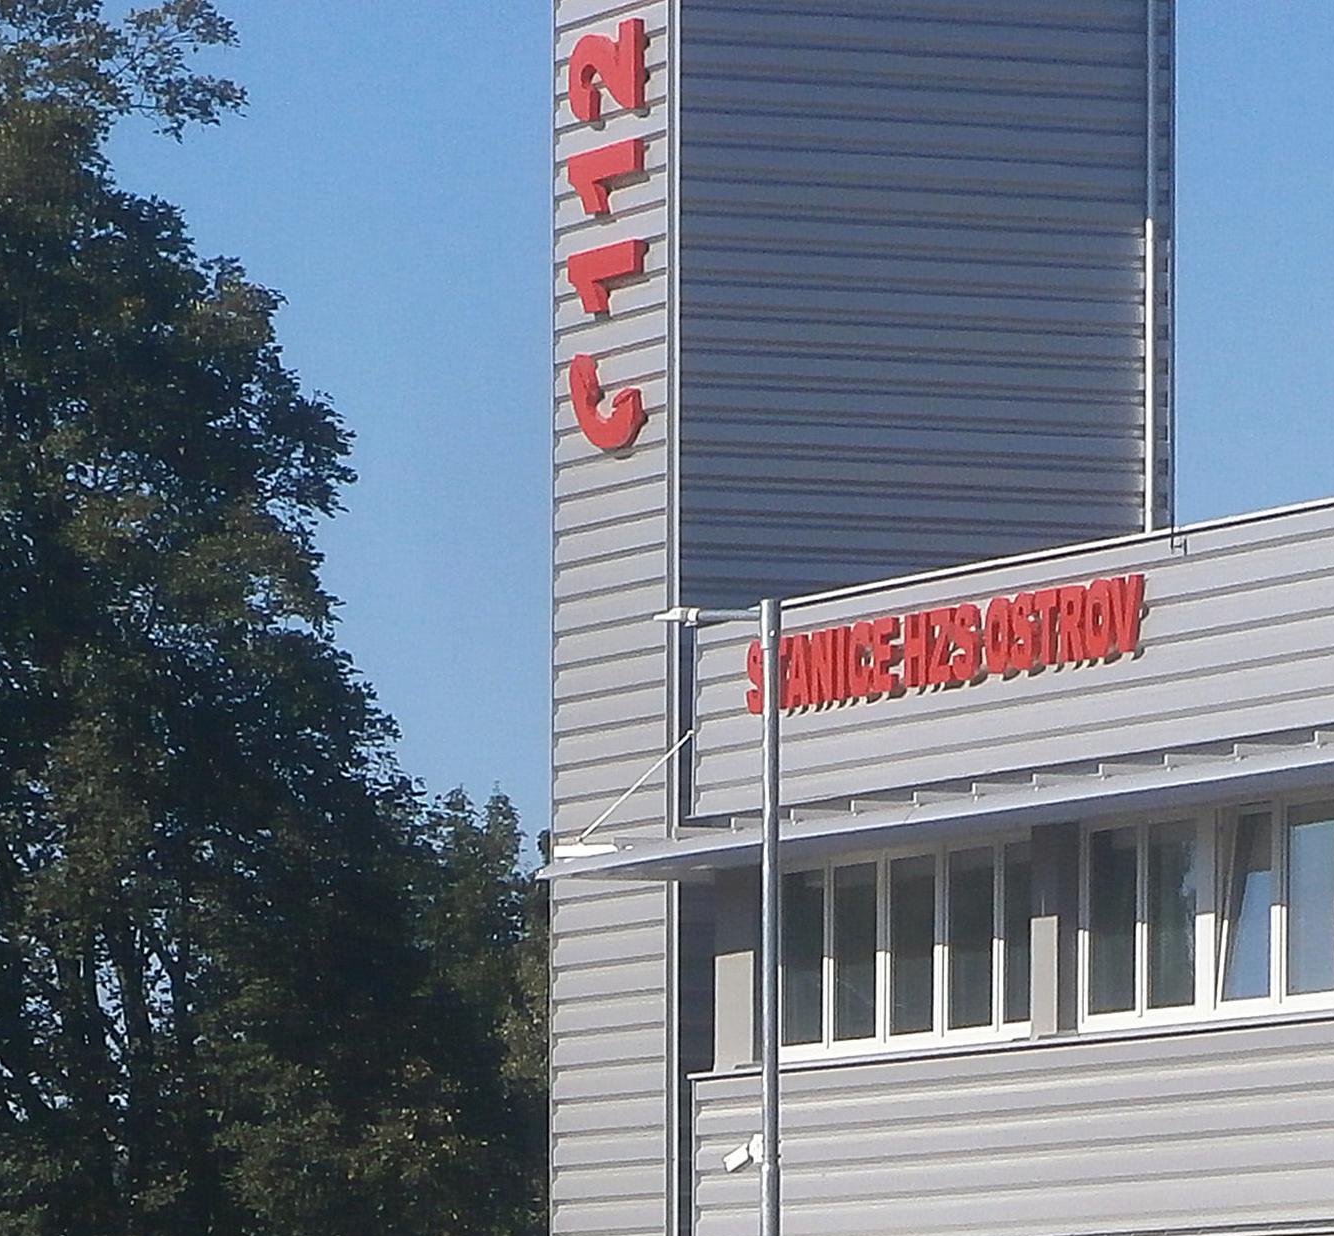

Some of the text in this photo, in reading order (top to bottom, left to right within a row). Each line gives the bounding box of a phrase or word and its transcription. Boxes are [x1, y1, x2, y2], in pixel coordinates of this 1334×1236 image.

[567, 17, 646, 313] 112
[903, 603, 982, 688] HZS
[984, 574, 1146, 675] OSTROV
